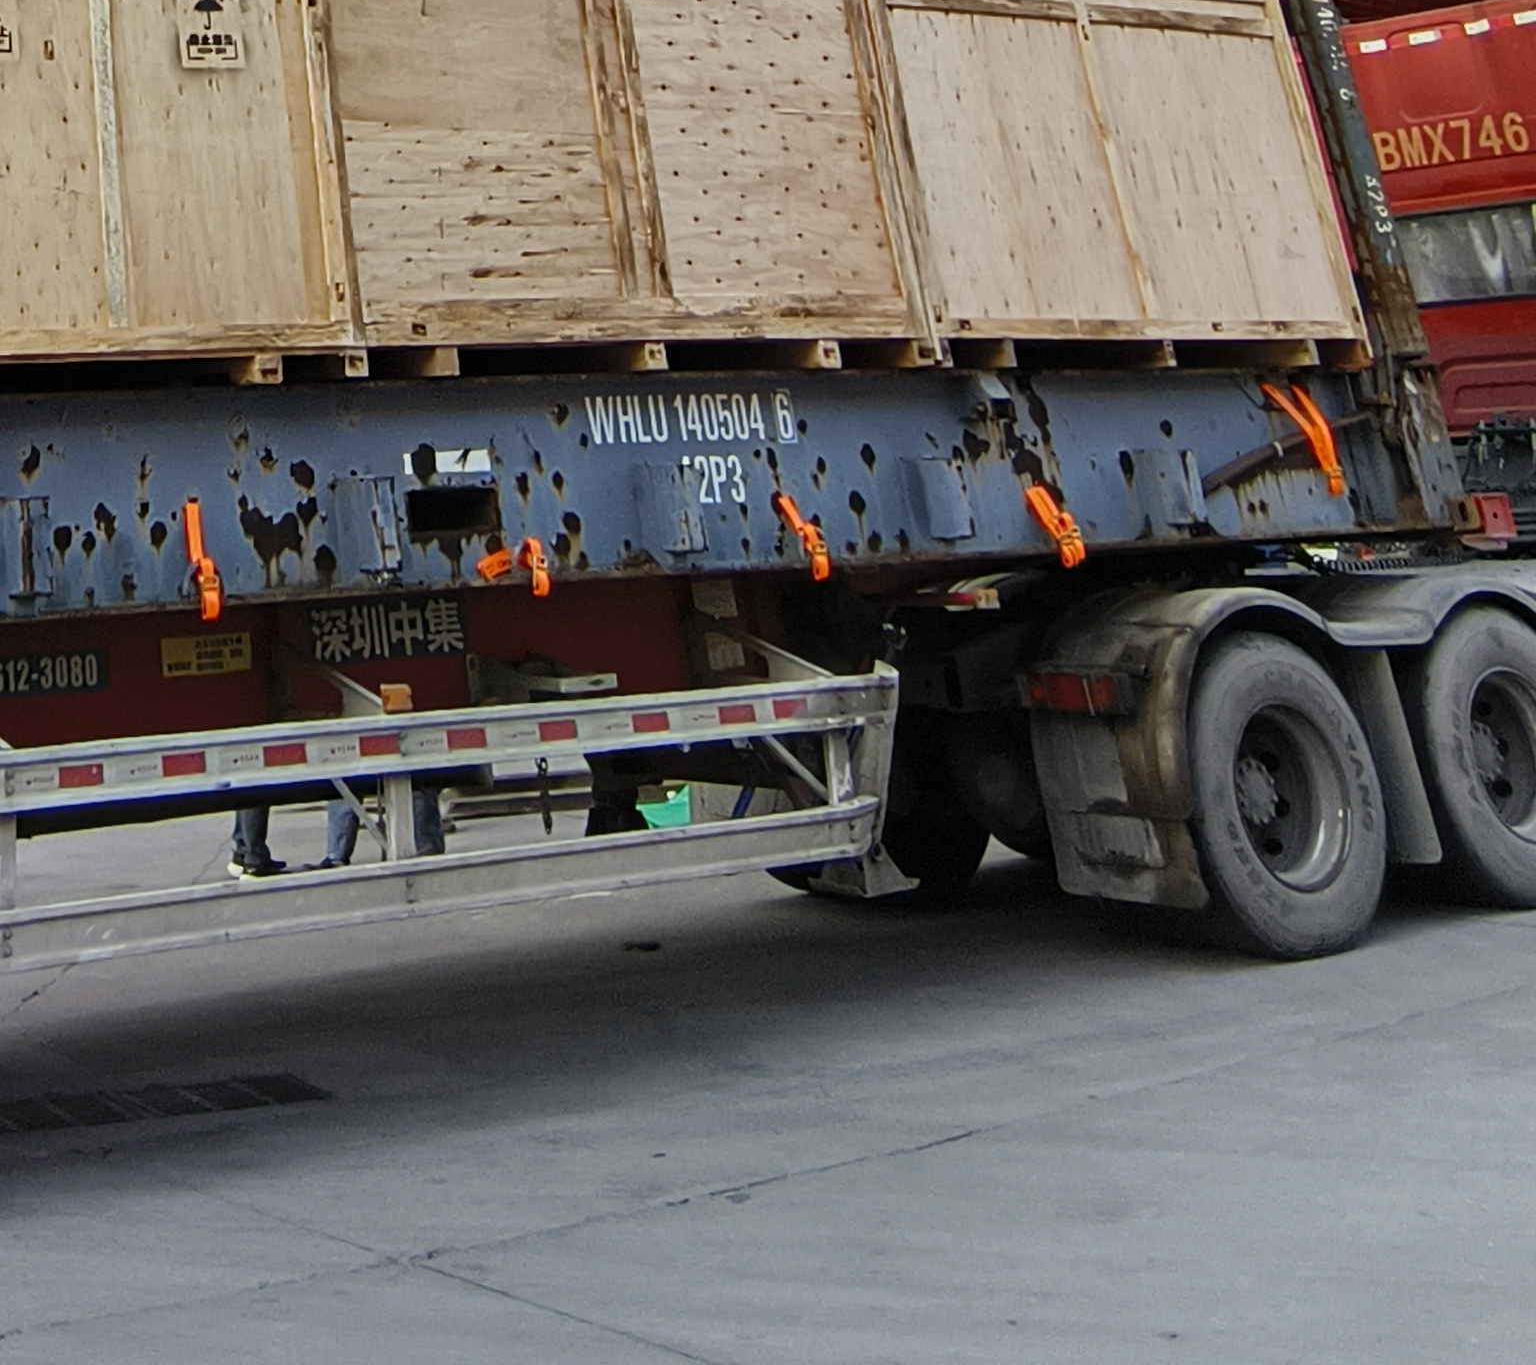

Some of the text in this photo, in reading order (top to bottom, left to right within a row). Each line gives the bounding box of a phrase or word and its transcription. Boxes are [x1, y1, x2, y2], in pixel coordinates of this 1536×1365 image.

[1372, 111, 1530, 172] BMX746
[584, 394, 670, 446] WHLU
[673, 392, 766, 443] 140504
[681, 455, 747, 505] 2P3
[311, 598, 465, 663] 深圳中集
